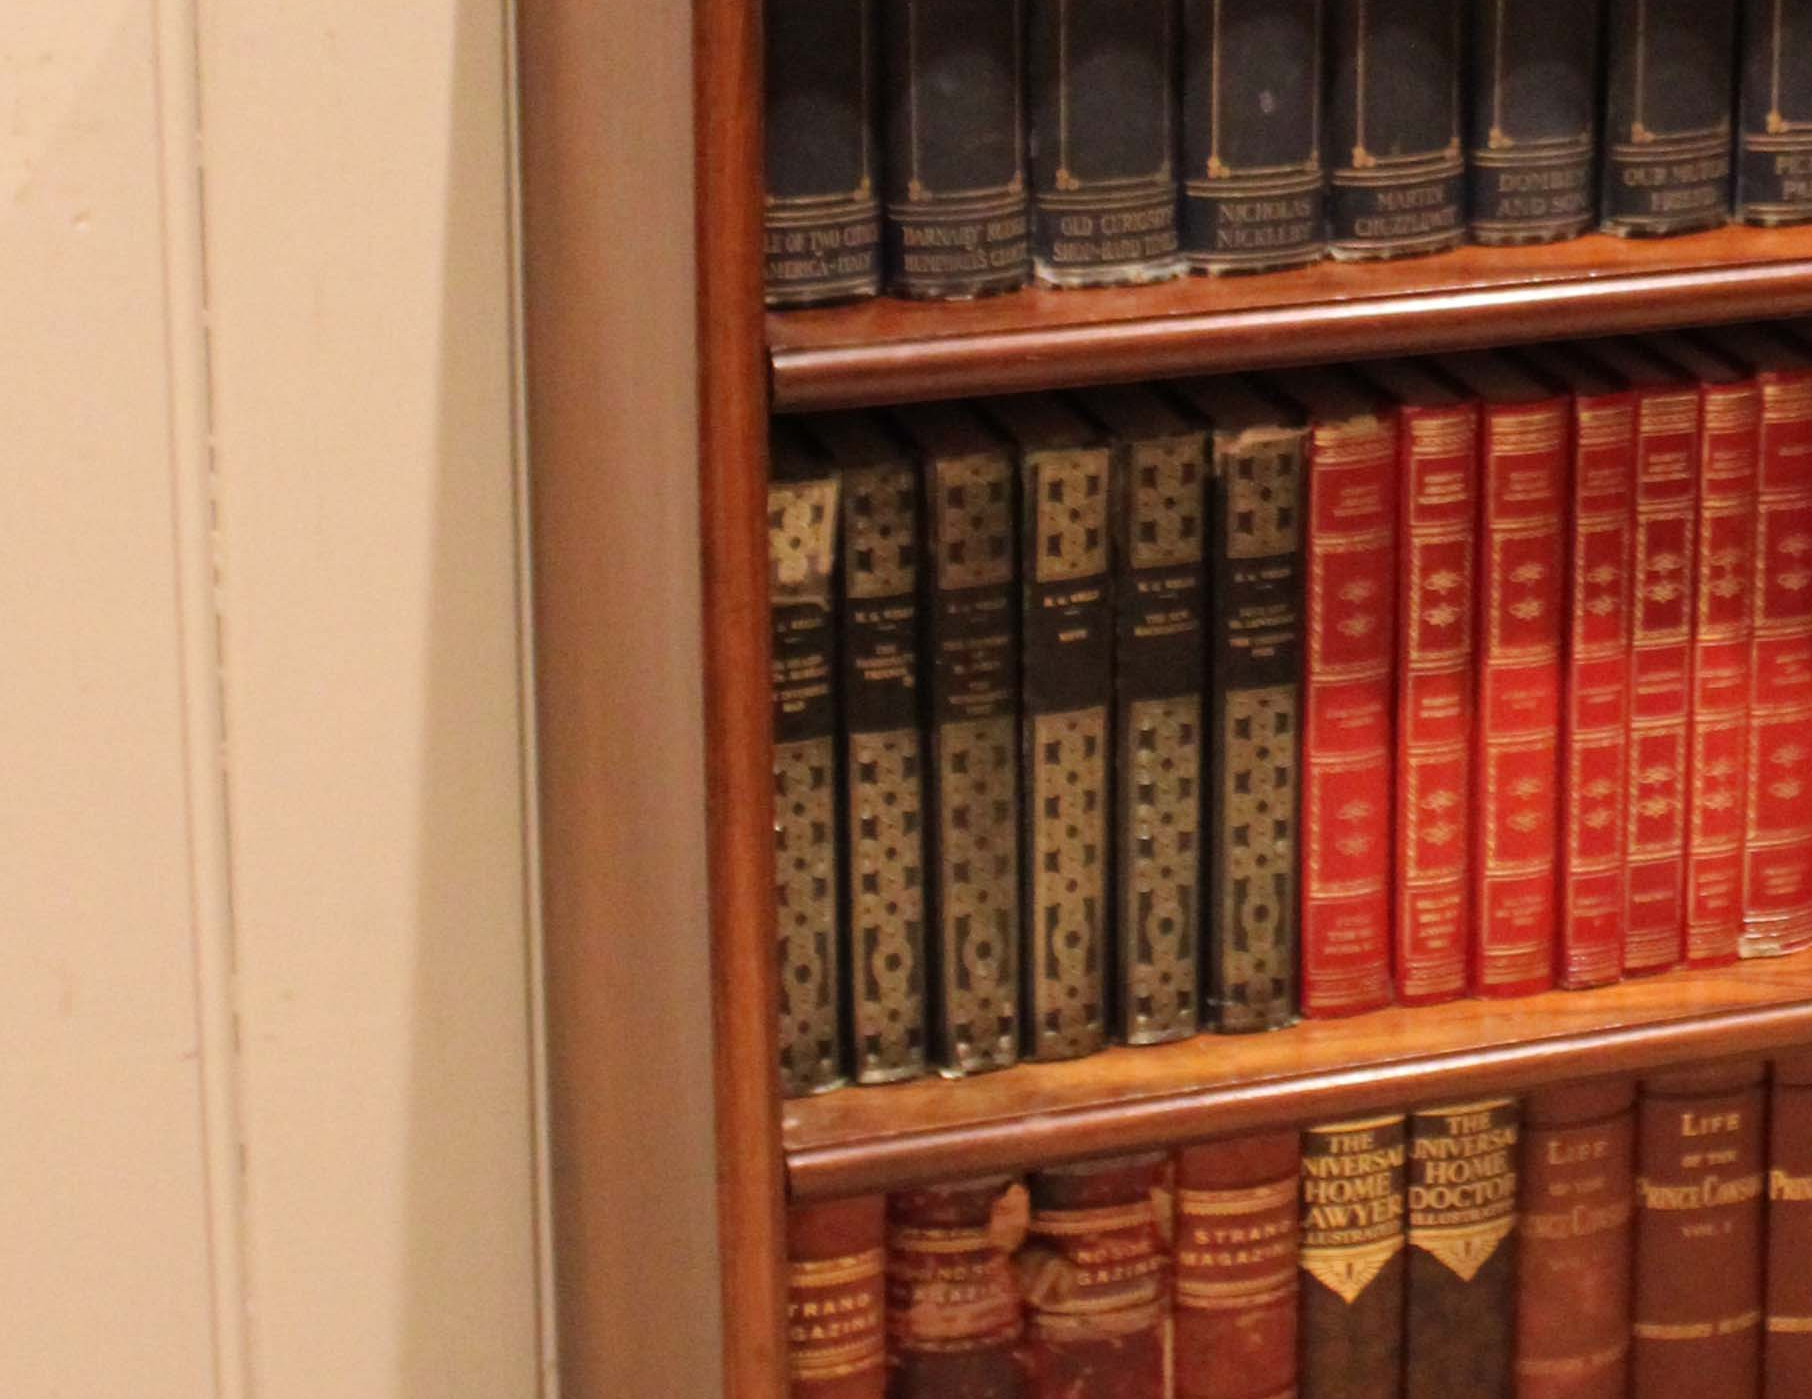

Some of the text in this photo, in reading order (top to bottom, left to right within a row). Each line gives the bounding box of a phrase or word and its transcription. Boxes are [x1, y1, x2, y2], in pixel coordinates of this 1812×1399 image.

[1448, 1112, 1490, 1135] THE
[1681, 1113, 1741, 1137] LIFE
[1328, 1135, 1374, 1154] THE
[1303, 1145, 1405, 1179] NIVERSA
[1424, 1149, 1509, 1185] HOME
[1305, 1172, 1391, 1204] HOME
[1305, 1195, 1405, 1230] AWYER
